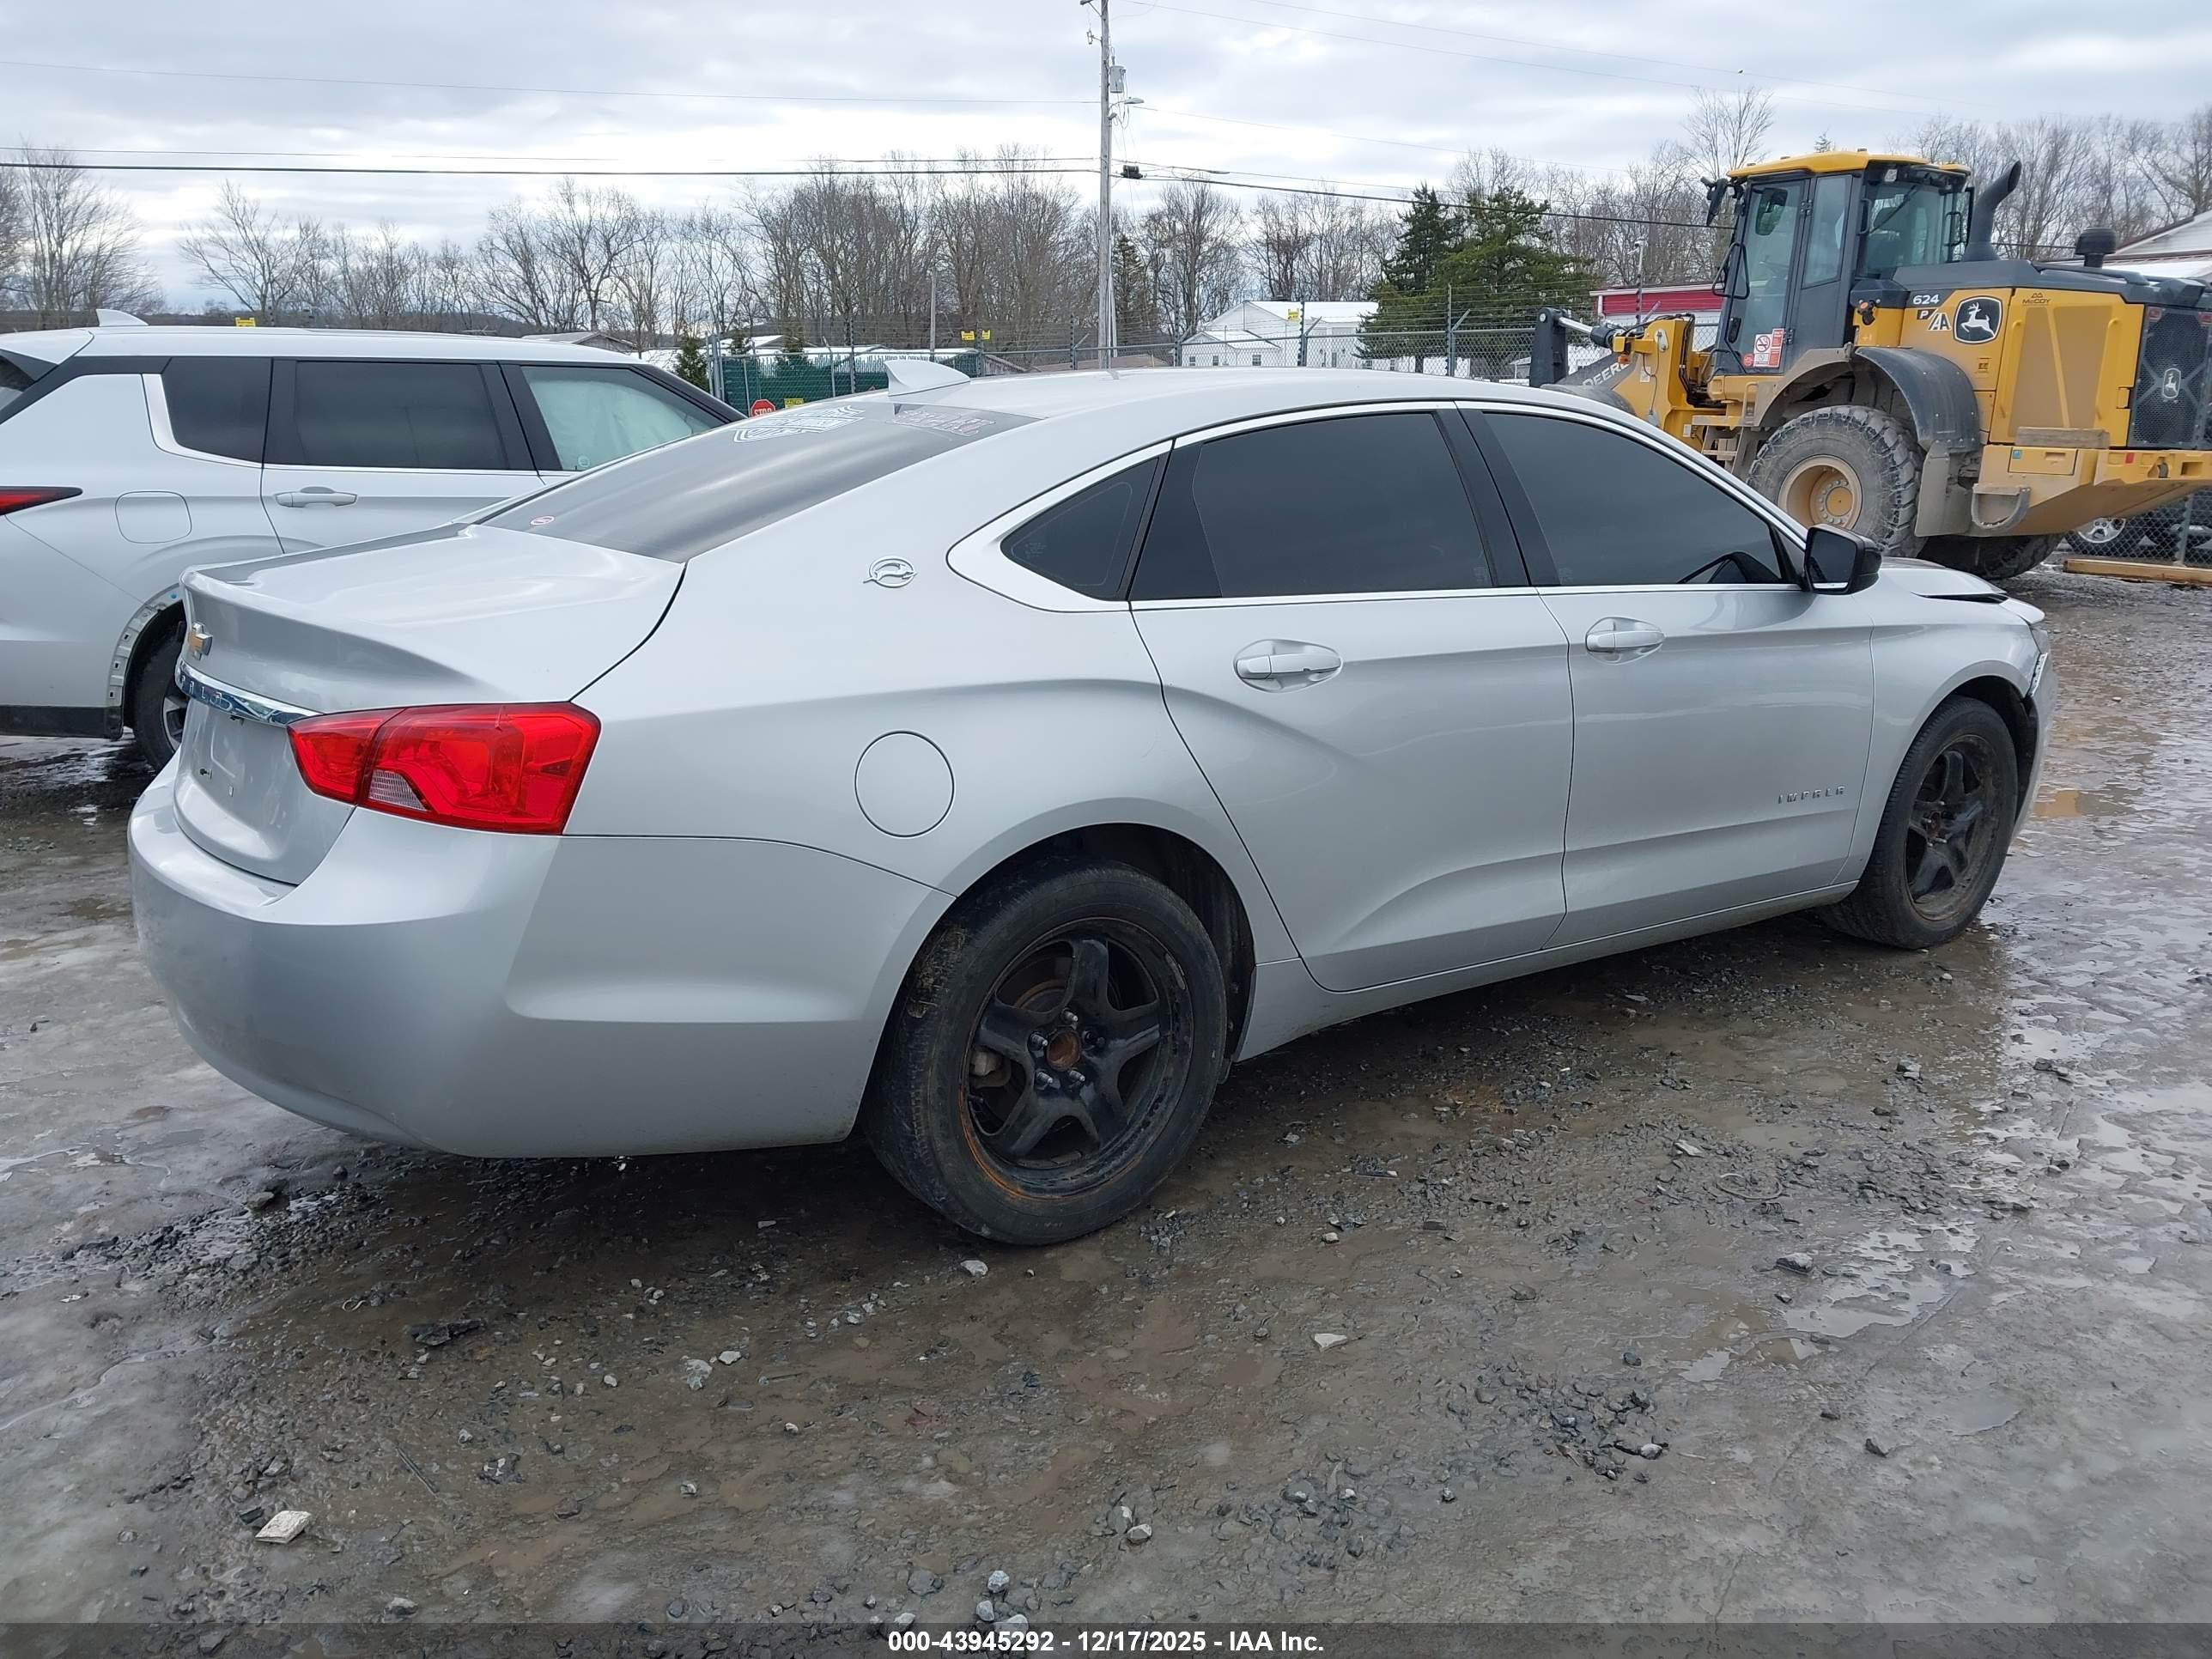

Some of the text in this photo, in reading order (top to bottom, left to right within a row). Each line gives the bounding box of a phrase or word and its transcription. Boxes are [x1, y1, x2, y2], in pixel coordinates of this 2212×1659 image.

[1912, 294, 1940, 305] 624
[1919, 310, 1929, 319] P
[1778, 786, 1845, 804] IMPALA
